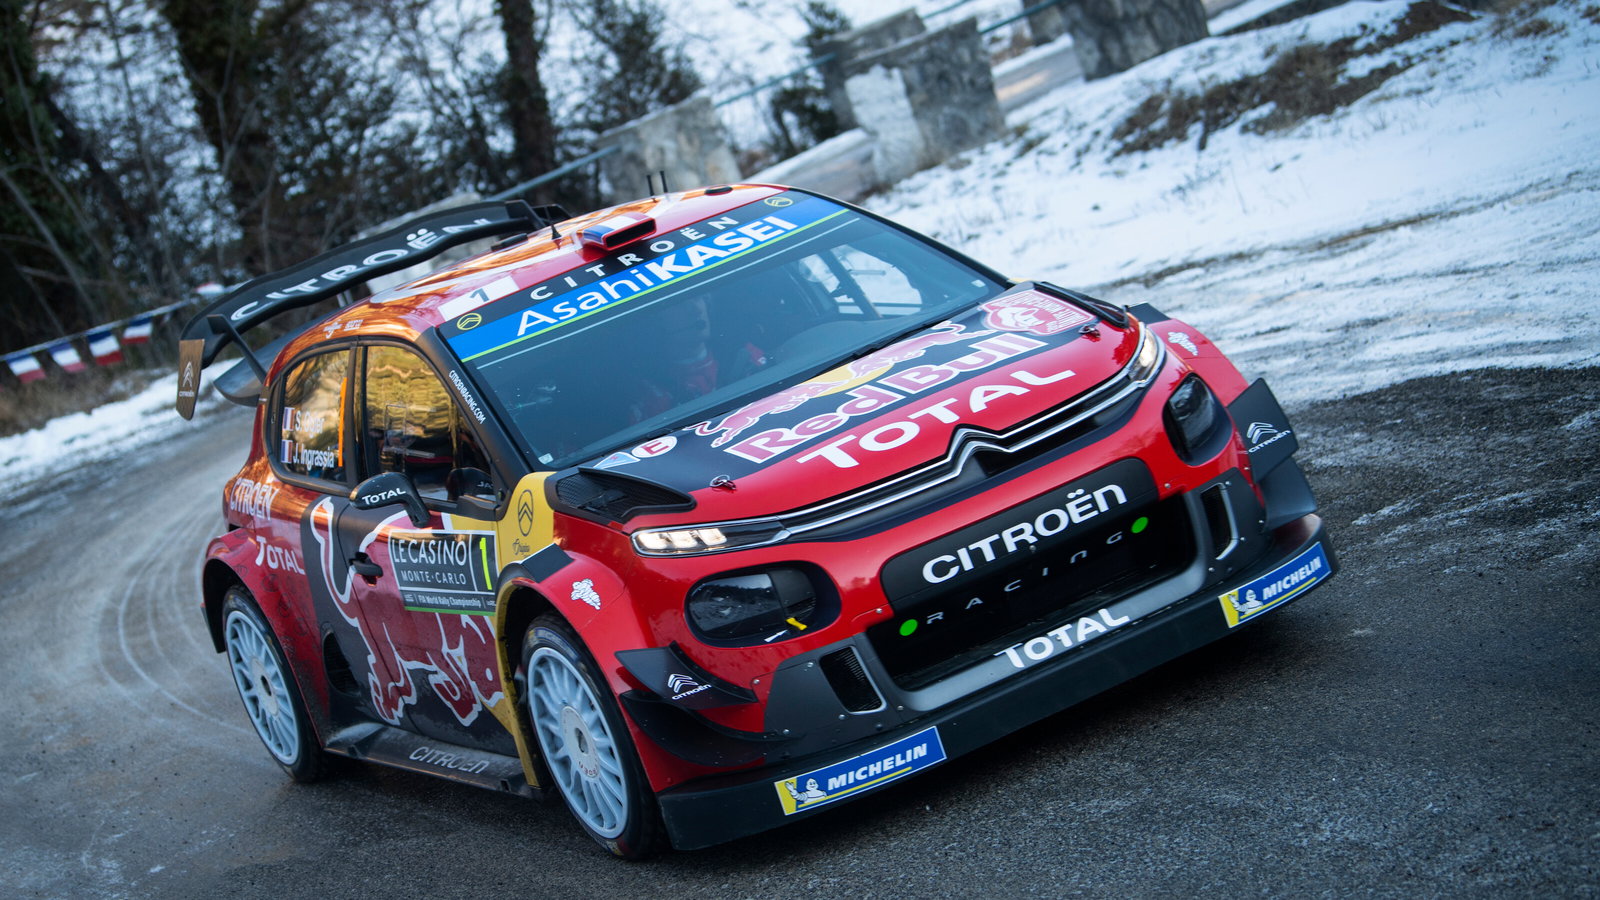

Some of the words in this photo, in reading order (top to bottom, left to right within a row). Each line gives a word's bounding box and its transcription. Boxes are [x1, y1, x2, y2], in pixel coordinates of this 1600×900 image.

[530, 216, 741, 300] CITROËN
[470, 288, 489, 302] 1
[797, 369, 1076, 469] TOTAL
[301, 443, 335, 471] Ingrassia
[361, 486, 407, 506] TOTAL
[255, 535, 306, 575] TOTAL
[392, 538, 407, 563] LE
[408, 539, 467, 566] CASINO
[922, 488, 1127, 584] CITROËN
[479, 537, 493, 591] 1
[926, 531, 1122, 625] RACING
[1261, 555, 1323, 601] MICHELIN
[450, 597, 481, 609] Championship
[993, 608, 1130, 669] TOTAL
[671, 683, 712, 700] CITROËN
[827, 742, 928, 791] MICHELIN
